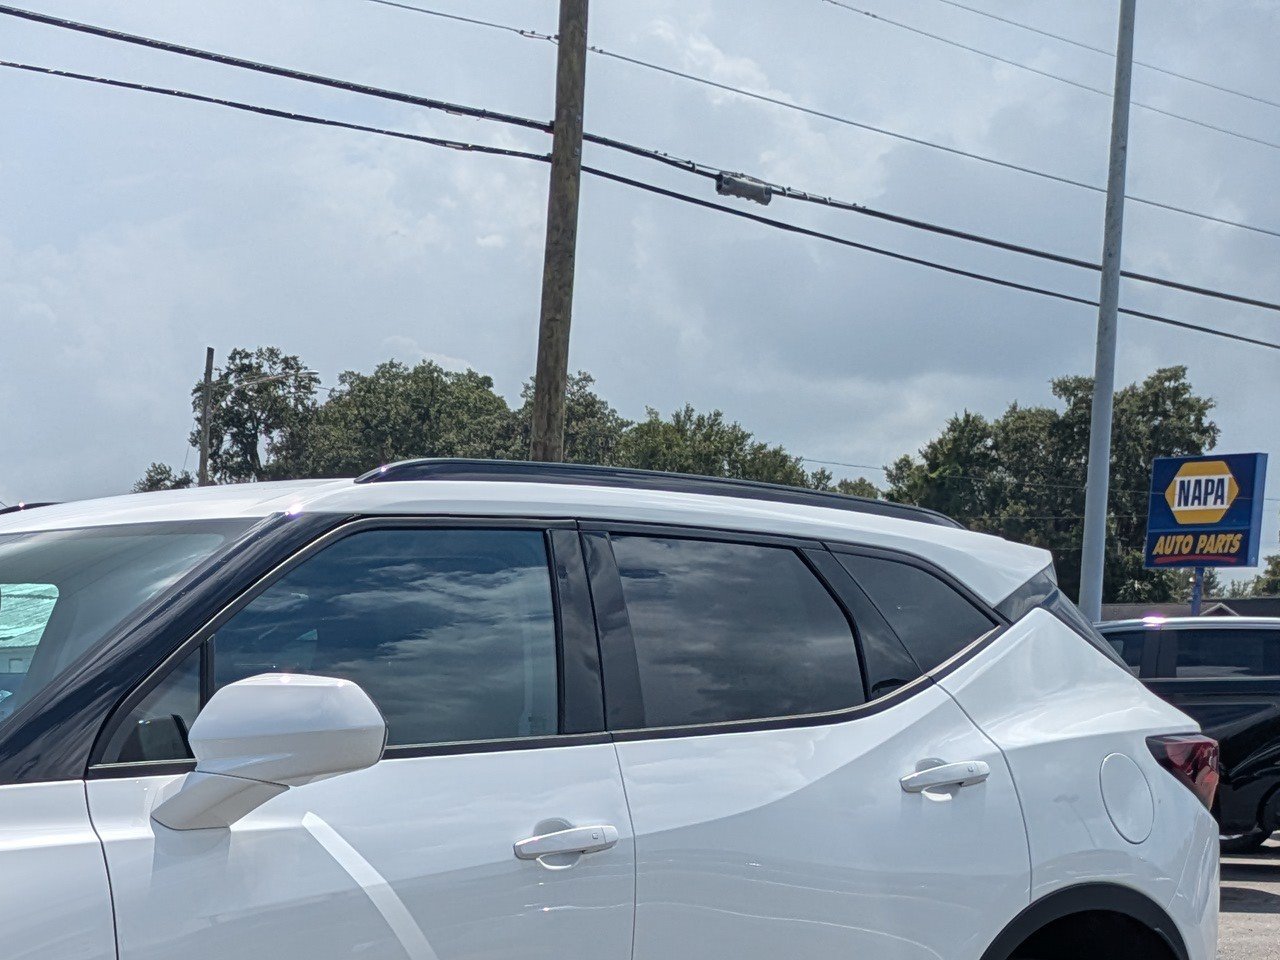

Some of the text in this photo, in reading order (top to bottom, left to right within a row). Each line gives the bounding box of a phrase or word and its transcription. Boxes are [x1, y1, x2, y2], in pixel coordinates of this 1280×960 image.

[1177, 478, 1225, 507] NAPA
[1152, 533, 1243, 555] AUTO PARTS
